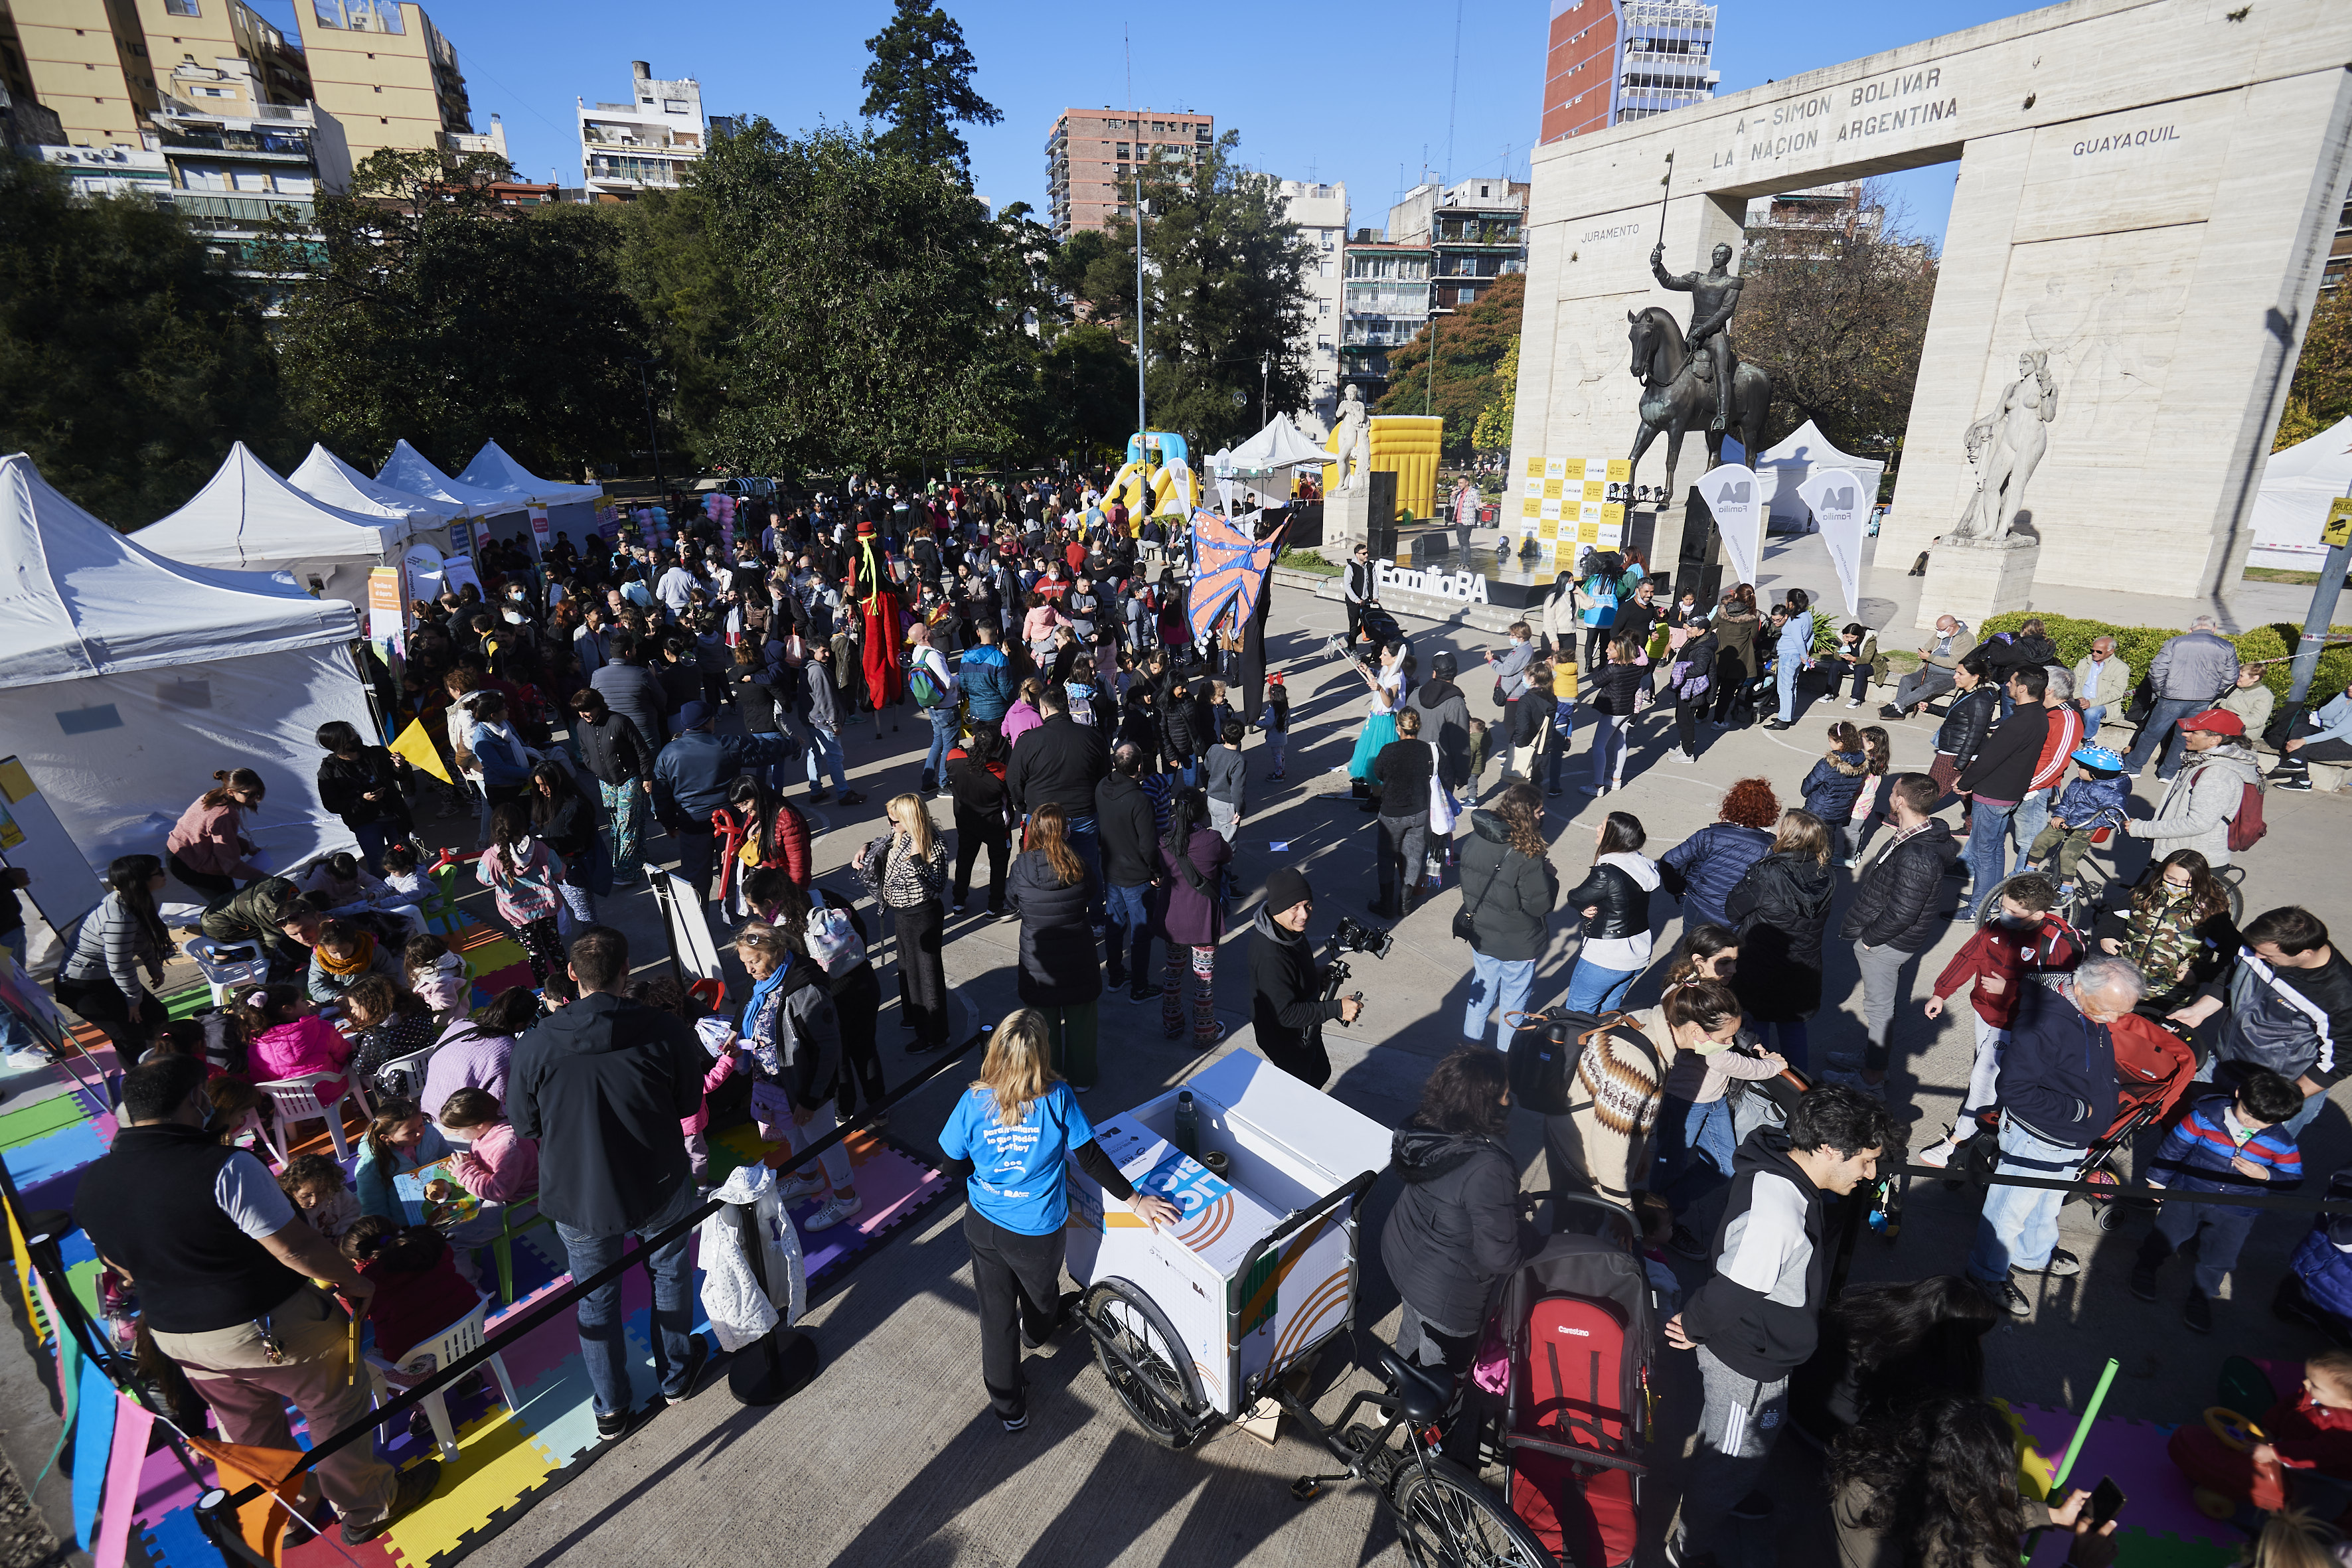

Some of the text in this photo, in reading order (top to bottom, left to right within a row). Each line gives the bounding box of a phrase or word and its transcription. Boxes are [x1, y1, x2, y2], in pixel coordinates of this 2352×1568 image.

[1736, 117, 1745, 135] A
[1773, 94, 1832, 126] SIMON
[1850, 68, 1940, 108] BOLIVAR
[1713, 98, 1957, 169] LA NACION ARGENTINA
[2073, 125, 2180, 156] GUAYAQUIL
[1581, 224, 1639, 243] JURAMENTO
[983, 1128, 1004, 1138] para
[1101, 1127, 1122, 1138] BA
[996, 1136, 1012, 1145] que
[997, 1142, 1030, 1152] leer hoy
[1121, 1155, 1135, 1165] ASE
[1066, 1181, 1101, 1214] BIBLIO
[1558, 1325, 1589, 1337] Carestino
